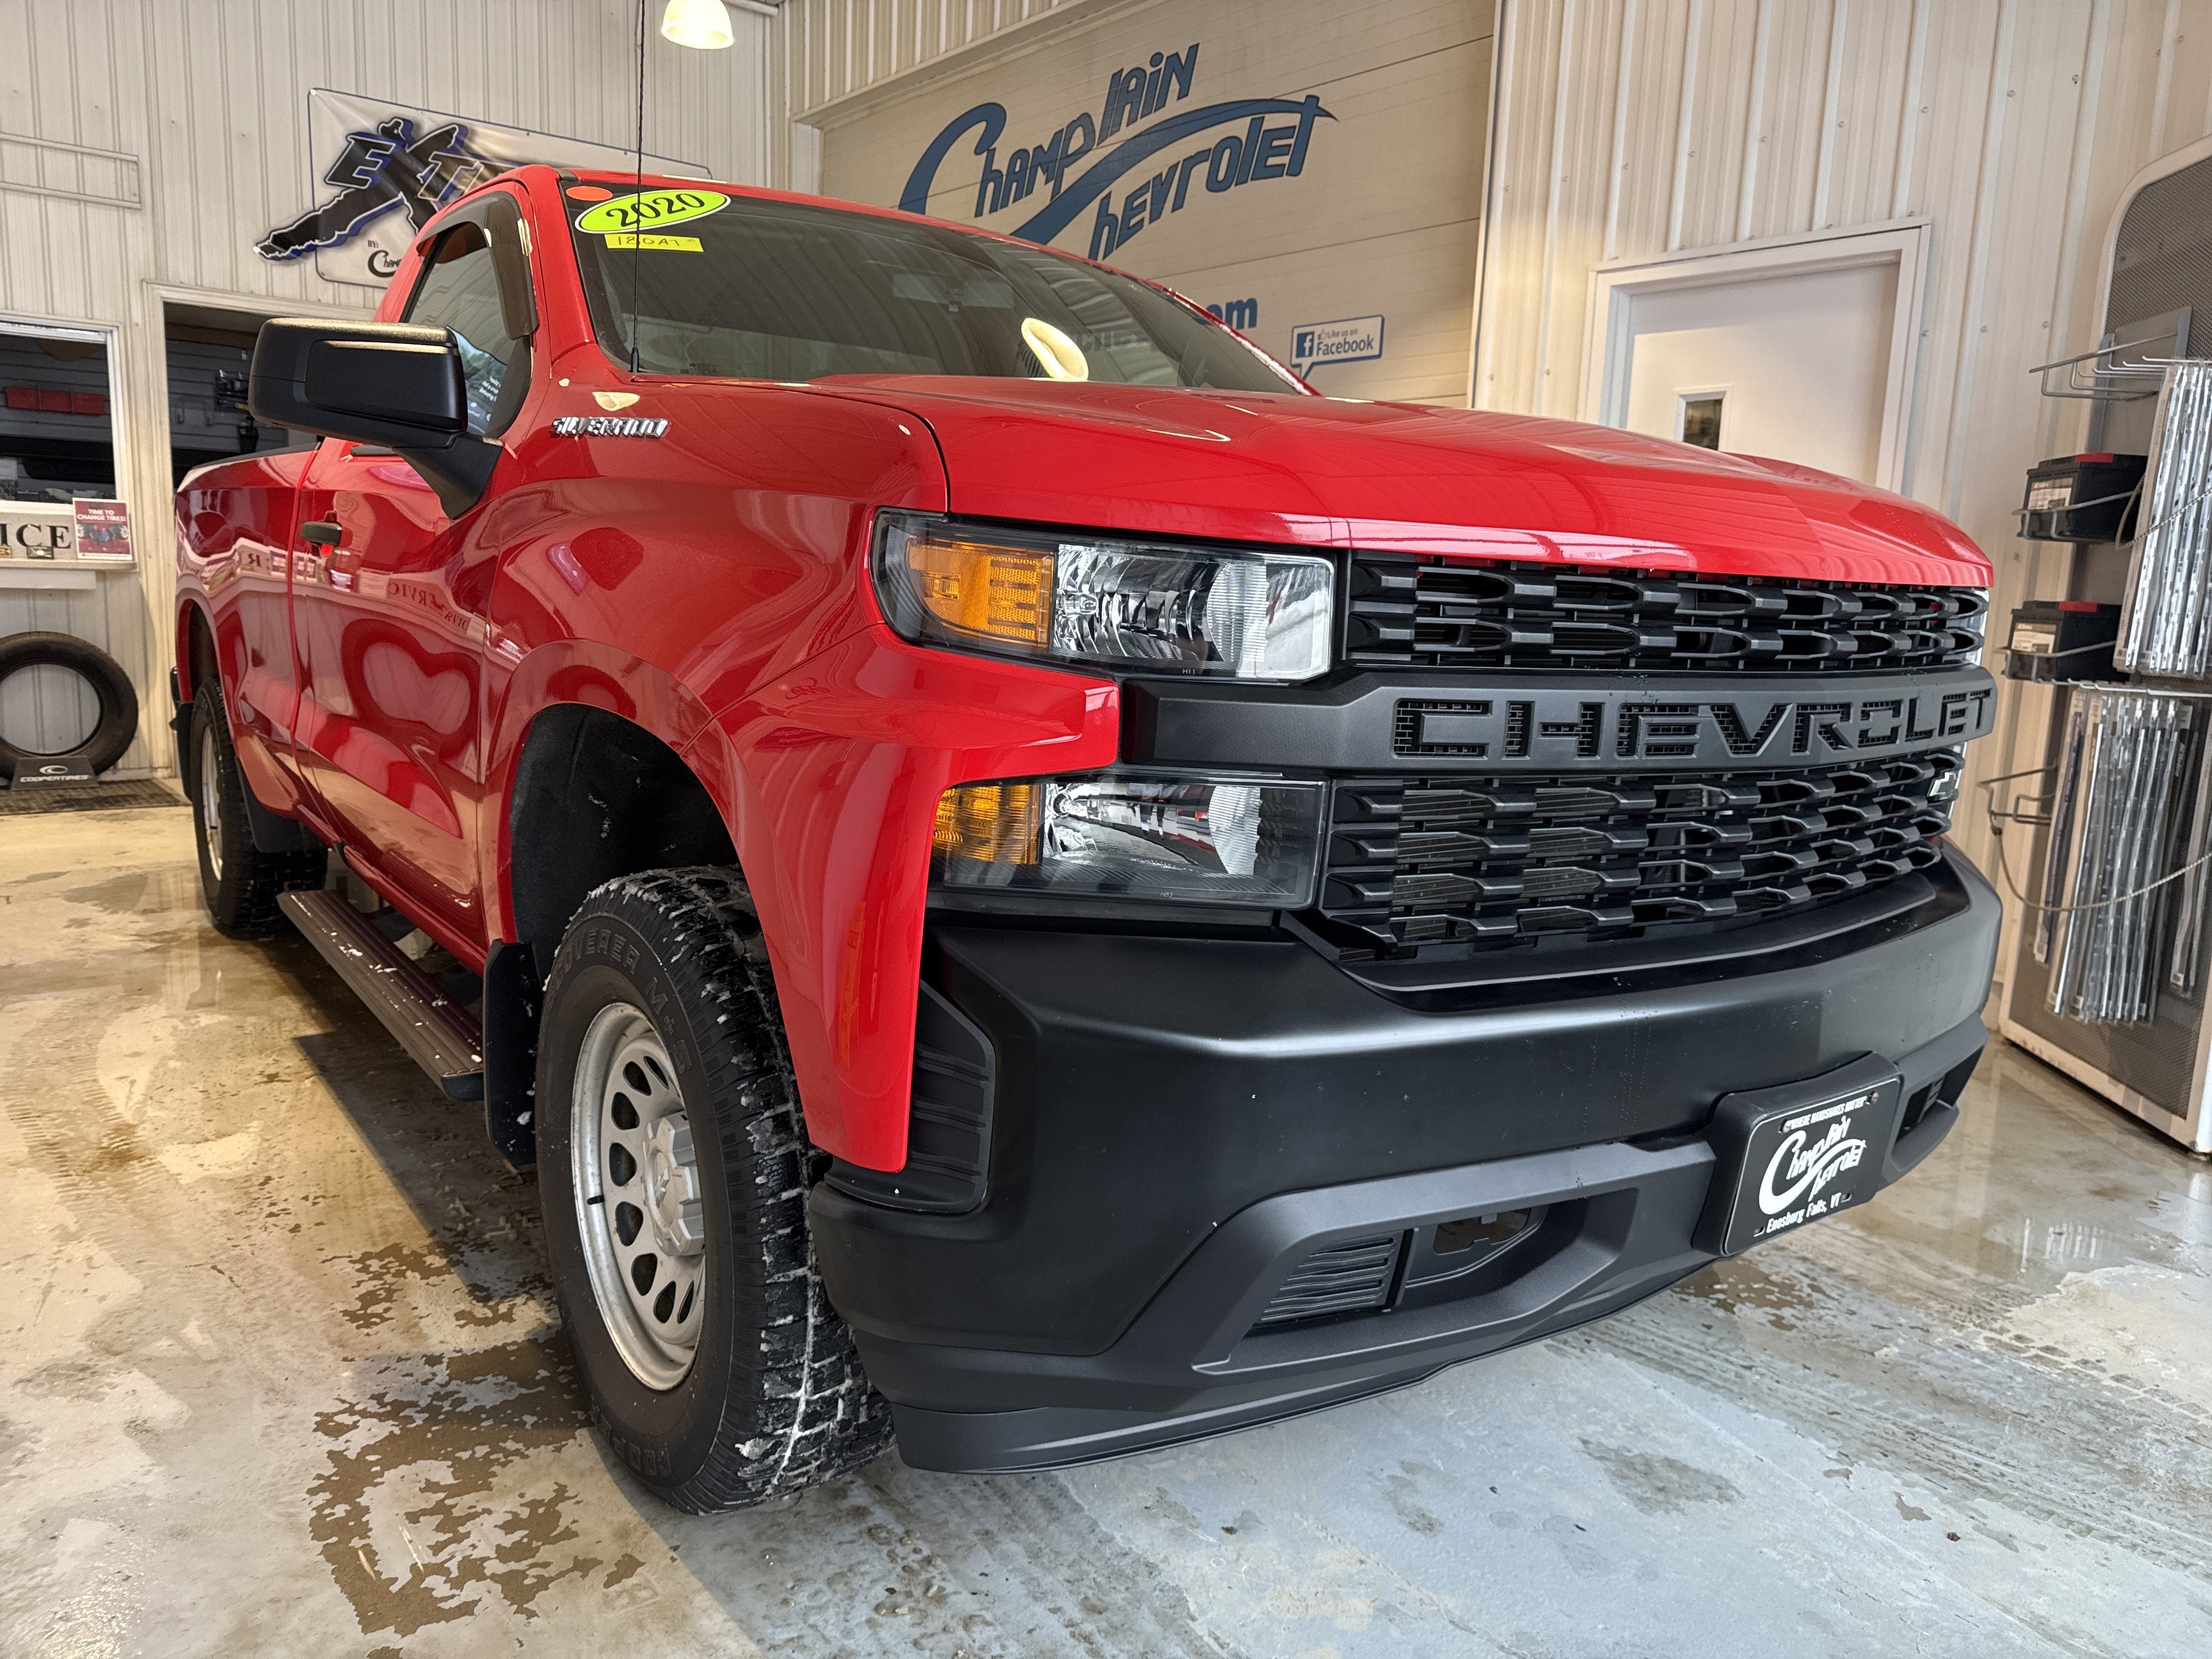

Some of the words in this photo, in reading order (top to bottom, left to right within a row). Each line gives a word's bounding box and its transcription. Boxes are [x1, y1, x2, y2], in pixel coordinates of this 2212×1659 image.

[606, 193, 706, 227] 2020
[1316, 334, 1374, 357] Facebook
[1328, 330, 1340, 339] Like
[1392, 689, 1993, 760] CHEVROLET
[1766, 1209, 1805, 1233] Enosburg
[1806, 1199, 1827, 1218] Falls,
[1830, 1192, 1842, 1208] VT
